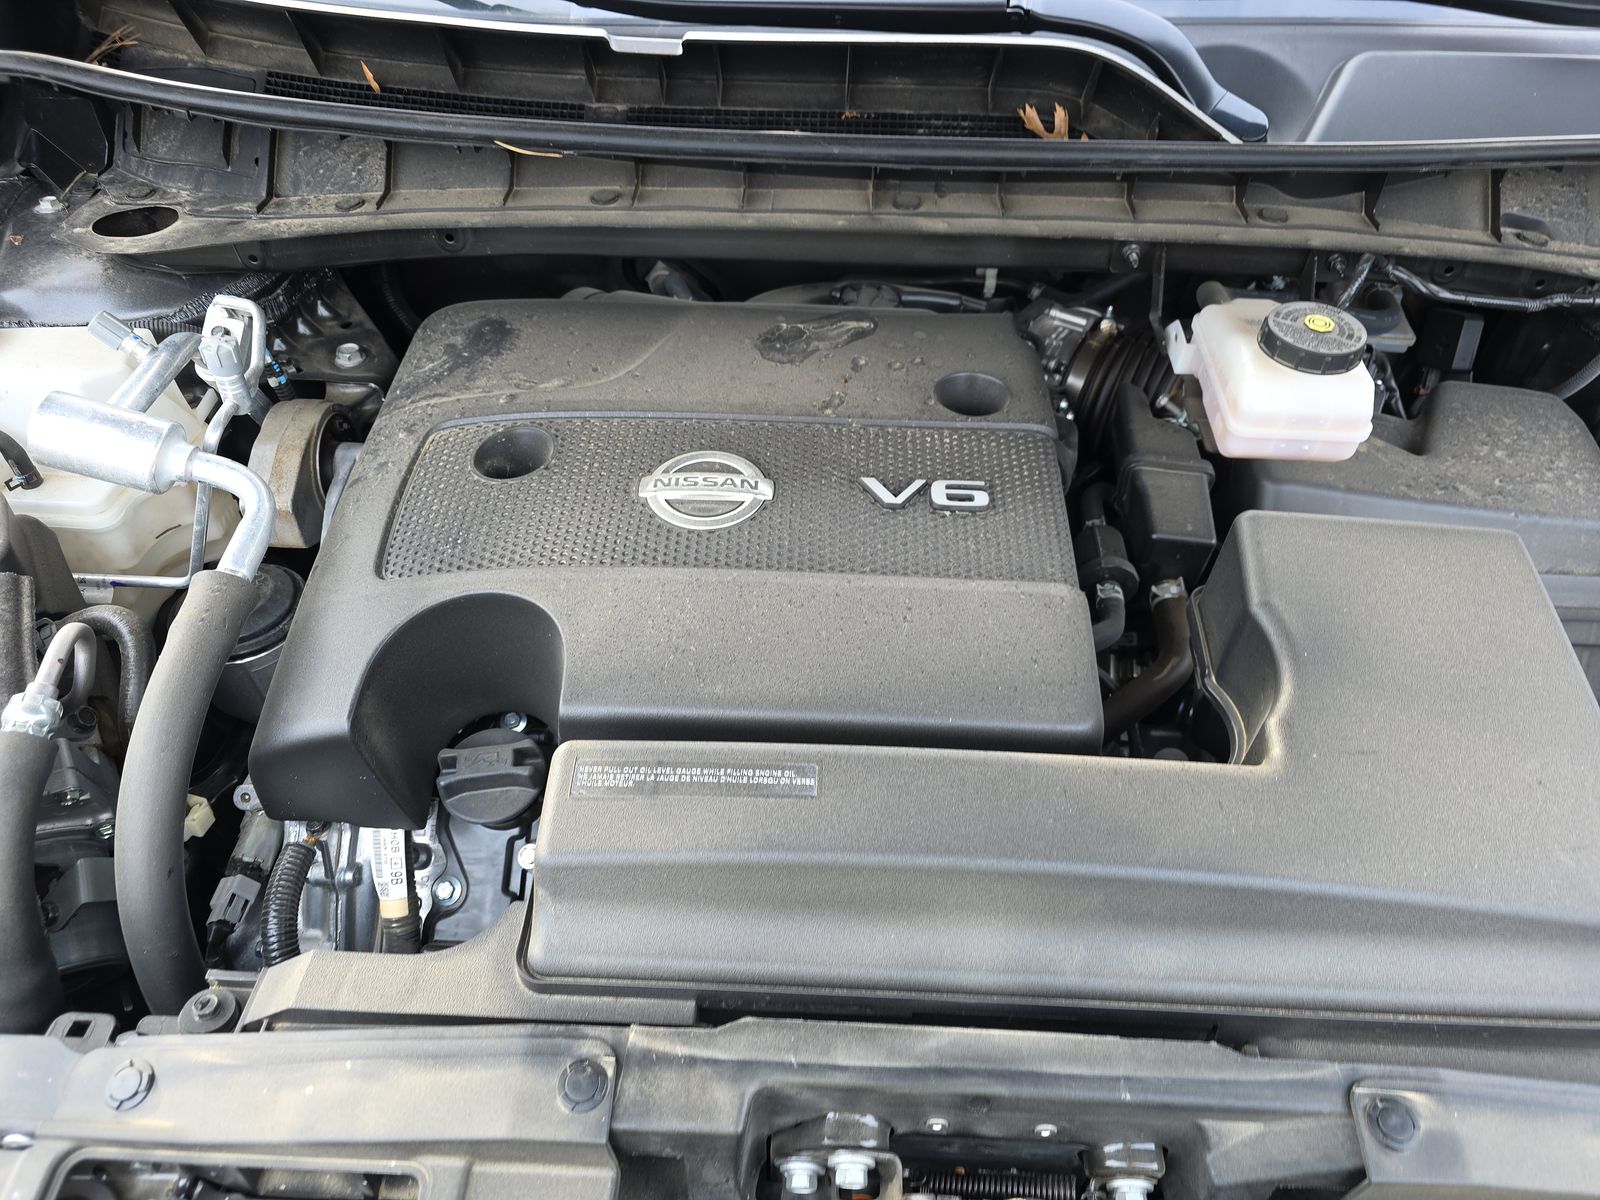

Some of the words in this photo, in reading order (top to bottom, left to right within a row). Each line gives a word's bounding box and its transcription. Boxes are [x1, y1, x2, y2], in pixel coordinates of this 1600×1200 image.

[652, 476, 760, 491] NISSAN
[857, 476, 990, 512] V6
[579, 765, 603, 774] NEVER
[604, 766, 621, 774] PULL
[623, 766, 639, 774] OUT
[640, 766, 652, 774] OIL
[653, 766, 674, 775] LEVEL
[675, 767, 701, 775] GAUGE
[702, 767, 725, 775] WHILE
[726, 768, 753, 776] FILLING
[754, 768, 782, 777] ENGINE
[646, 773, 656, 782] LA
[656, 774, 680, 782] JAUGE
[680, 774, 691, 782] DE
[692, 775, 718, 783] NIVEAU
[719, 775, 748, 784] D'HUILE
